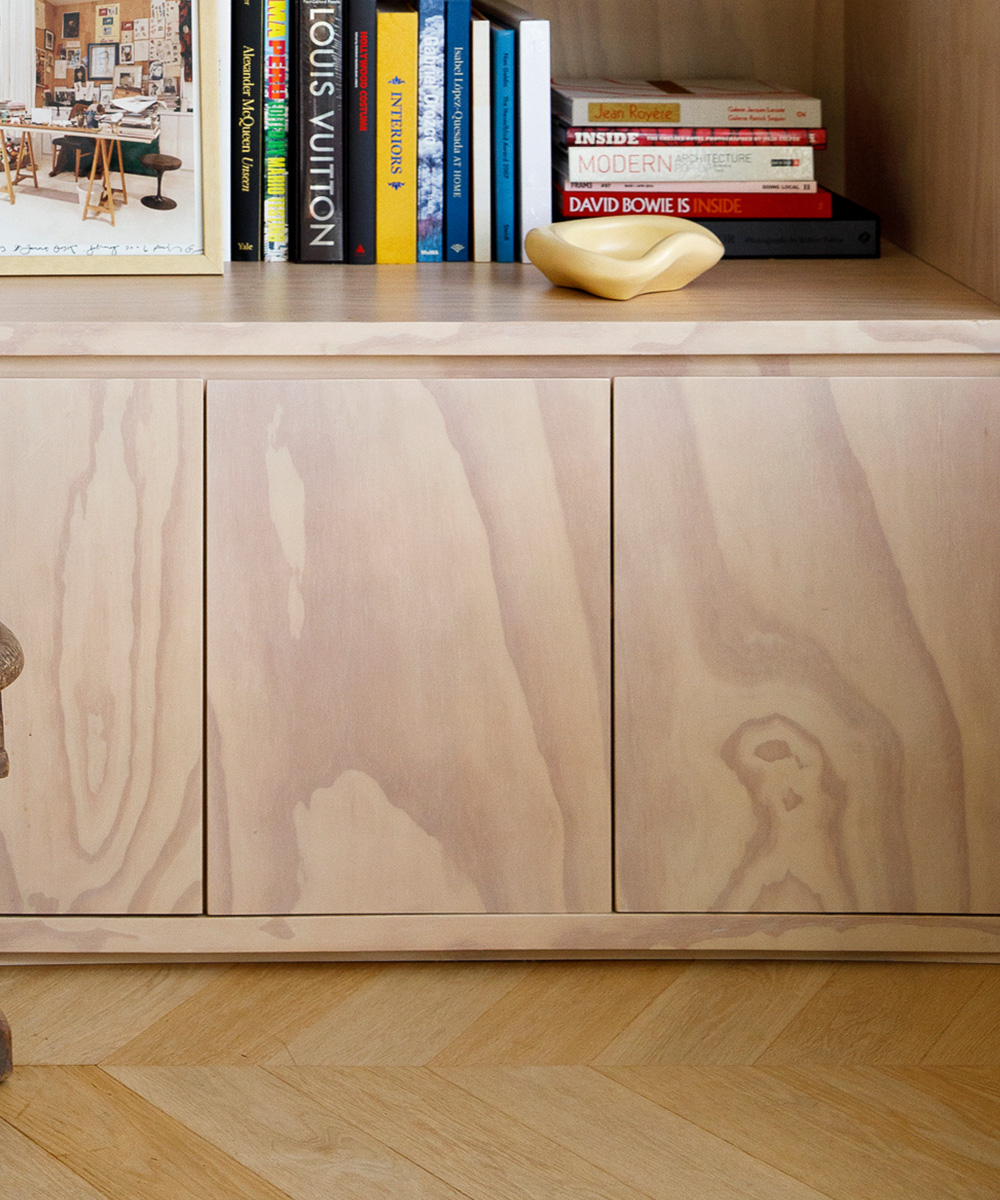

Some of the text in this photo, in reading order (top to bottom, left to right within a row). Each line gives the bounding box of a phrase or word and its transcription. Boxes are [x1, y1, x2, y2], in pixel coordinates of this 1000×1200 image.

[242, 45, 255, 97] Alexander
[268, 40, 285, 100] PERU
[359, 31, 368, 132] HOLLYWOOD COSTUME
[423, 36, 438, 145] Gabriel Orozco
[239, 99, 255, 153] McQueen
[268, 102, 285, 138] EDITED
[309, 7, 335, 246] LOUIS VUITTON
[390, 91, 403, 175] INTERIORS
[452, 46, 464, 198] Isabel López-Quesada AT HOME
[268, 140, 285, 156] BY
[578, 153, 752, 174] MODERN ARCHITECTURE
[241, 157, 251, 192] Unseen
[267, 157, 285, 195] MARIO
[268, 197, 285, 242] TESTINO
[569, 197, 742, 214] DAVID BOWIE IS INSIDE
